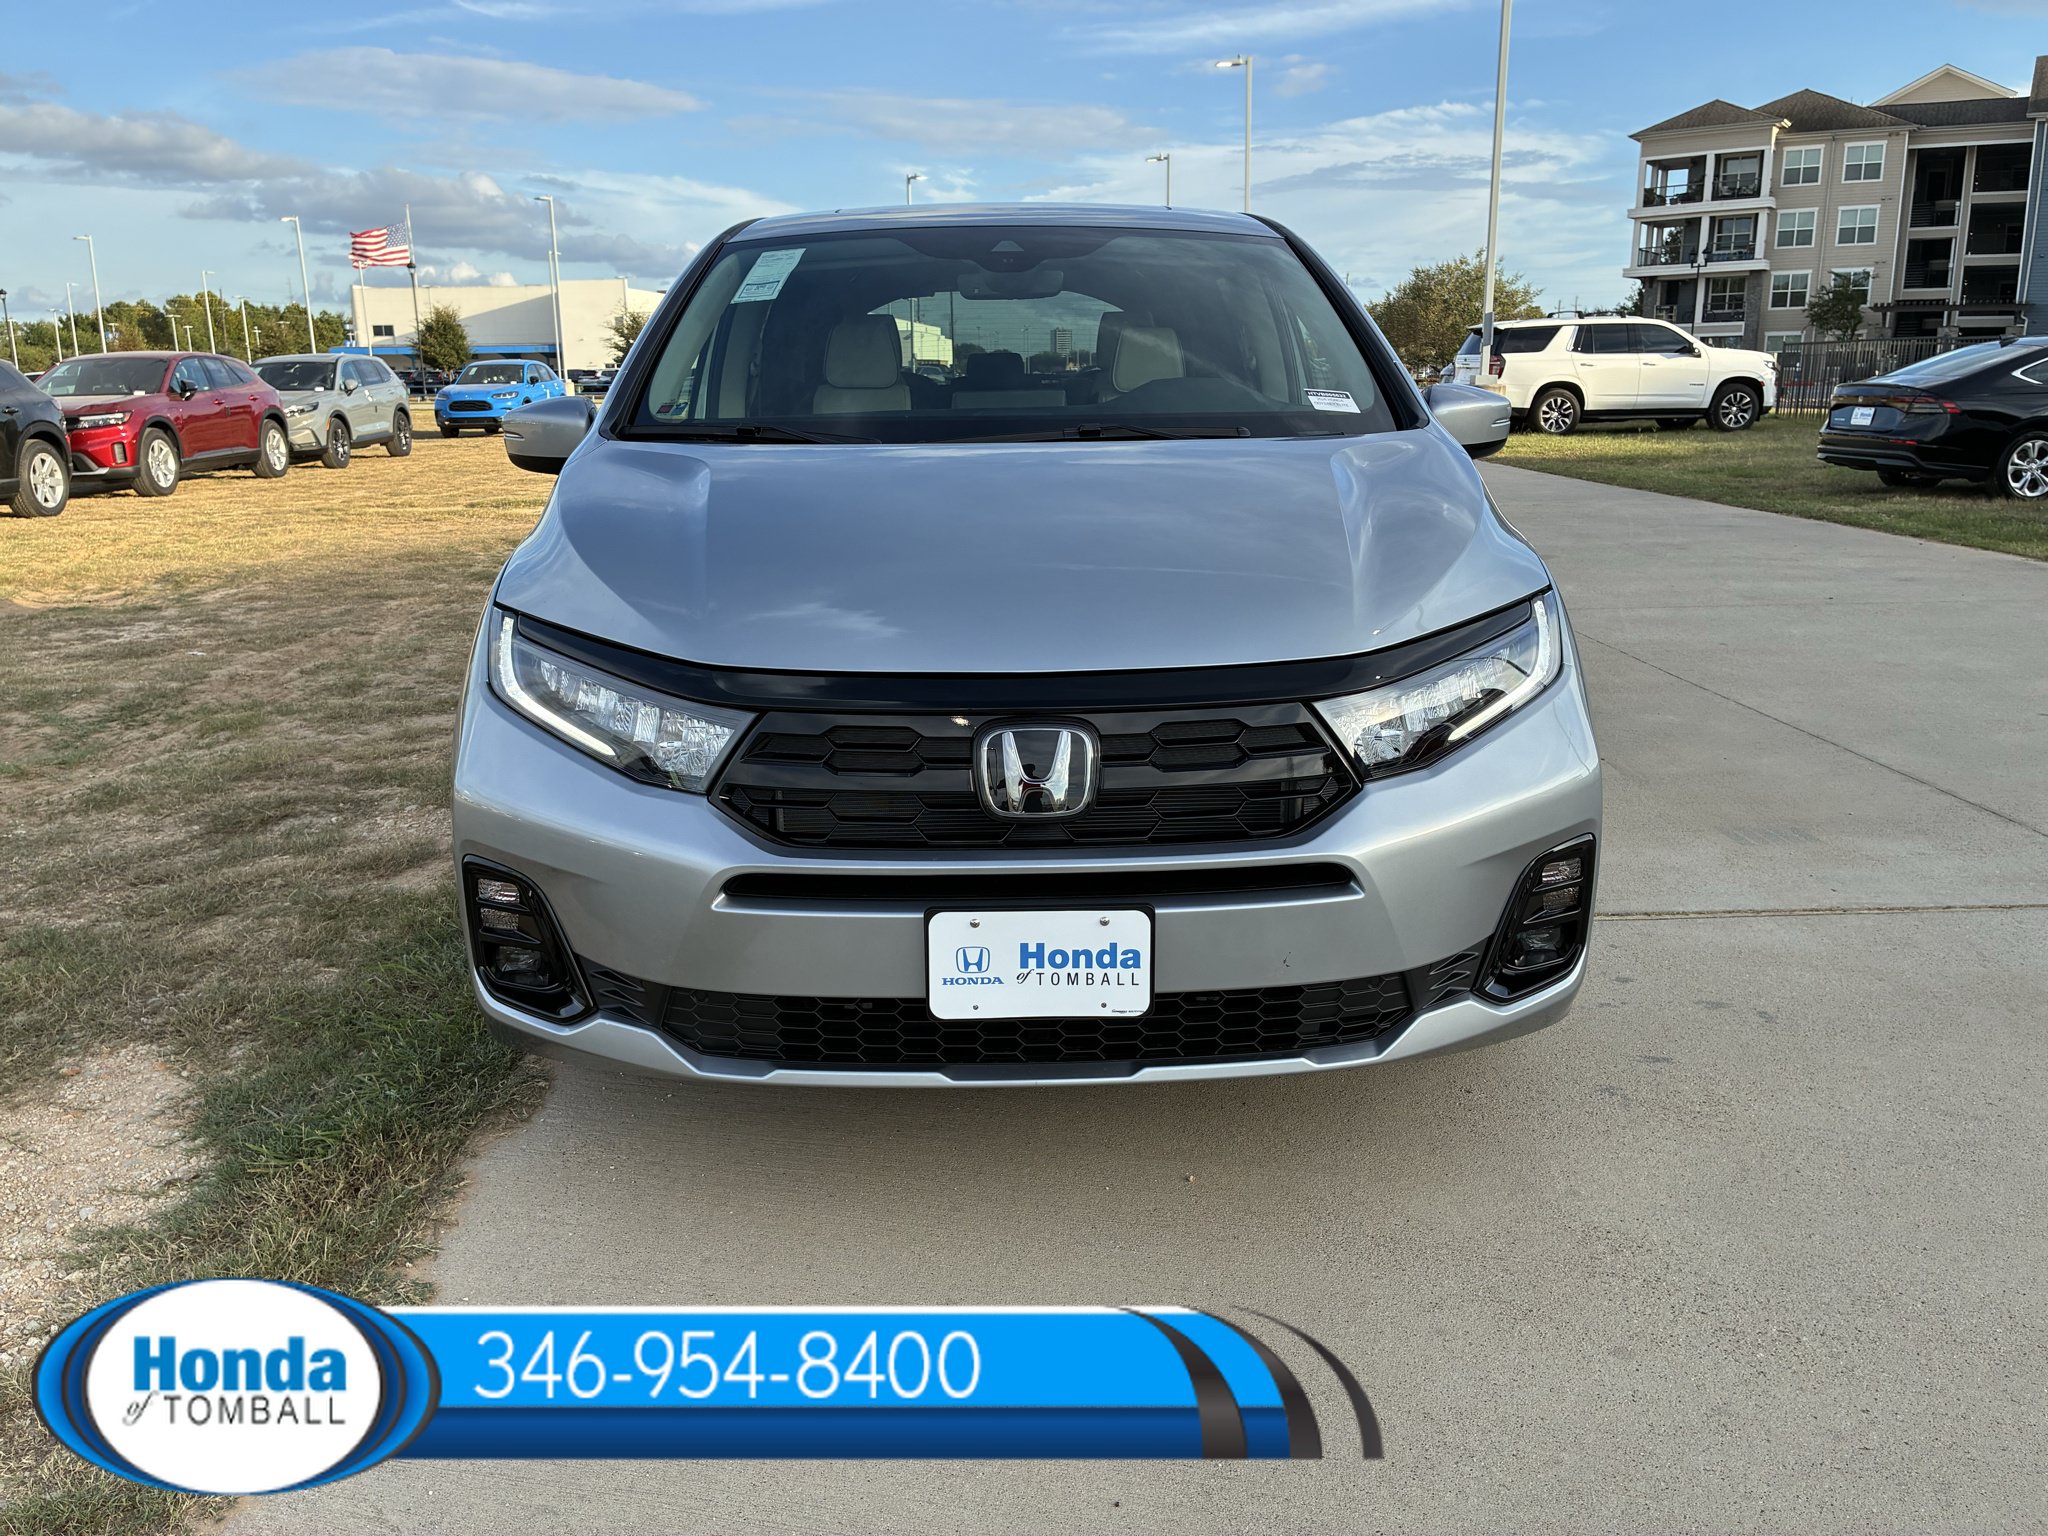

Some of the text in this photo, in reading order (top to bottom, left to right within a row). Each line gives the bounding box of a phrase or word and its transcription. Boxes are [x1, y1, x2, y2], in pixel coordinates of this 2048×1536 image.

[1019, 942, 1141, 969] Honda
[942, 976, 1004, 985] HONDA
[1016, 969, 1139, 986] of TOMBALL
